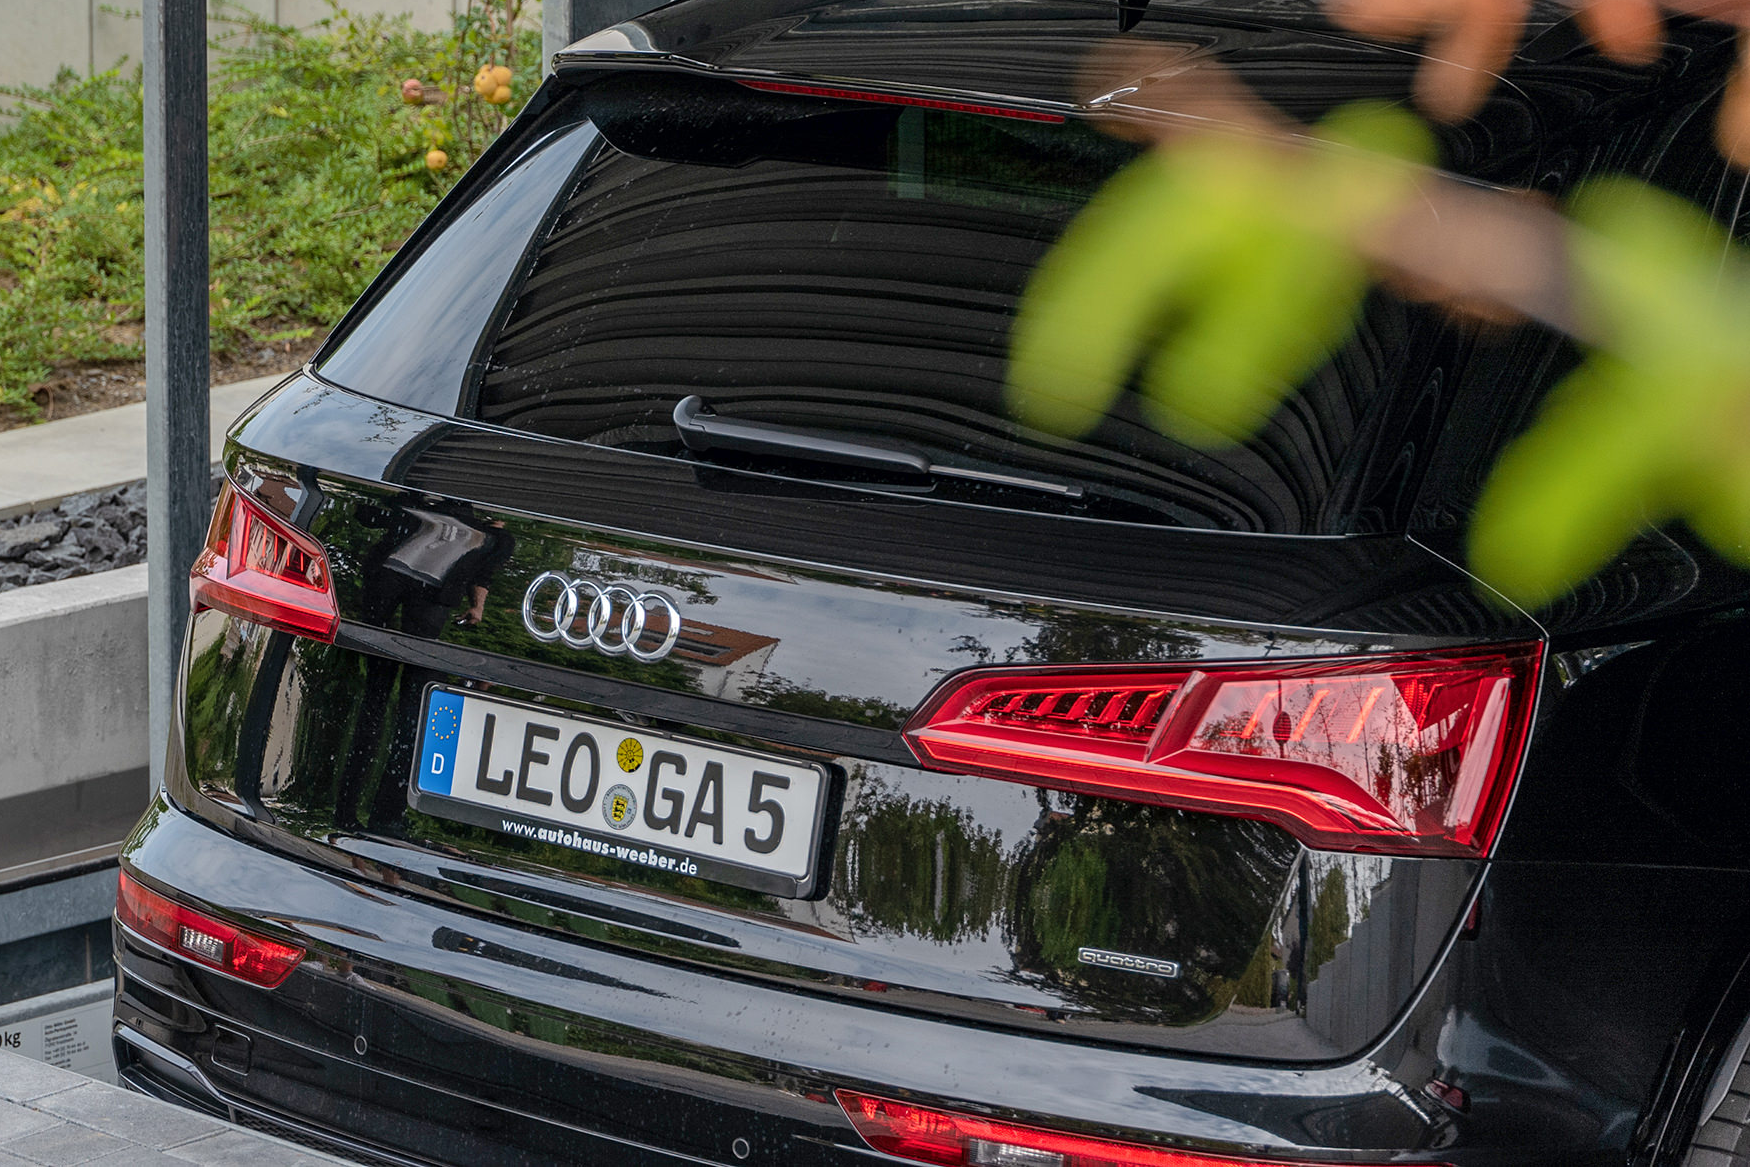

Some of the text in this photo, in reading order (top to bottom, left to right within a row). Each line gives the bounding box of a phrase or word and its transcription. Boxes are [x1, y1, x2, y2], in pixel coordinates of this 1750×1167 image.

[431, 752, 444, 775] D
[475, 713, 600, 814] LEO
[643, 750, 724, 845] GA
[744, 770, 791, 854] 5
[501, 818, 698, 876] www.autohaus-weeber.de
[1082, 951, 1172, 974] quattro
[4, 1031, 21, 1049] kg
